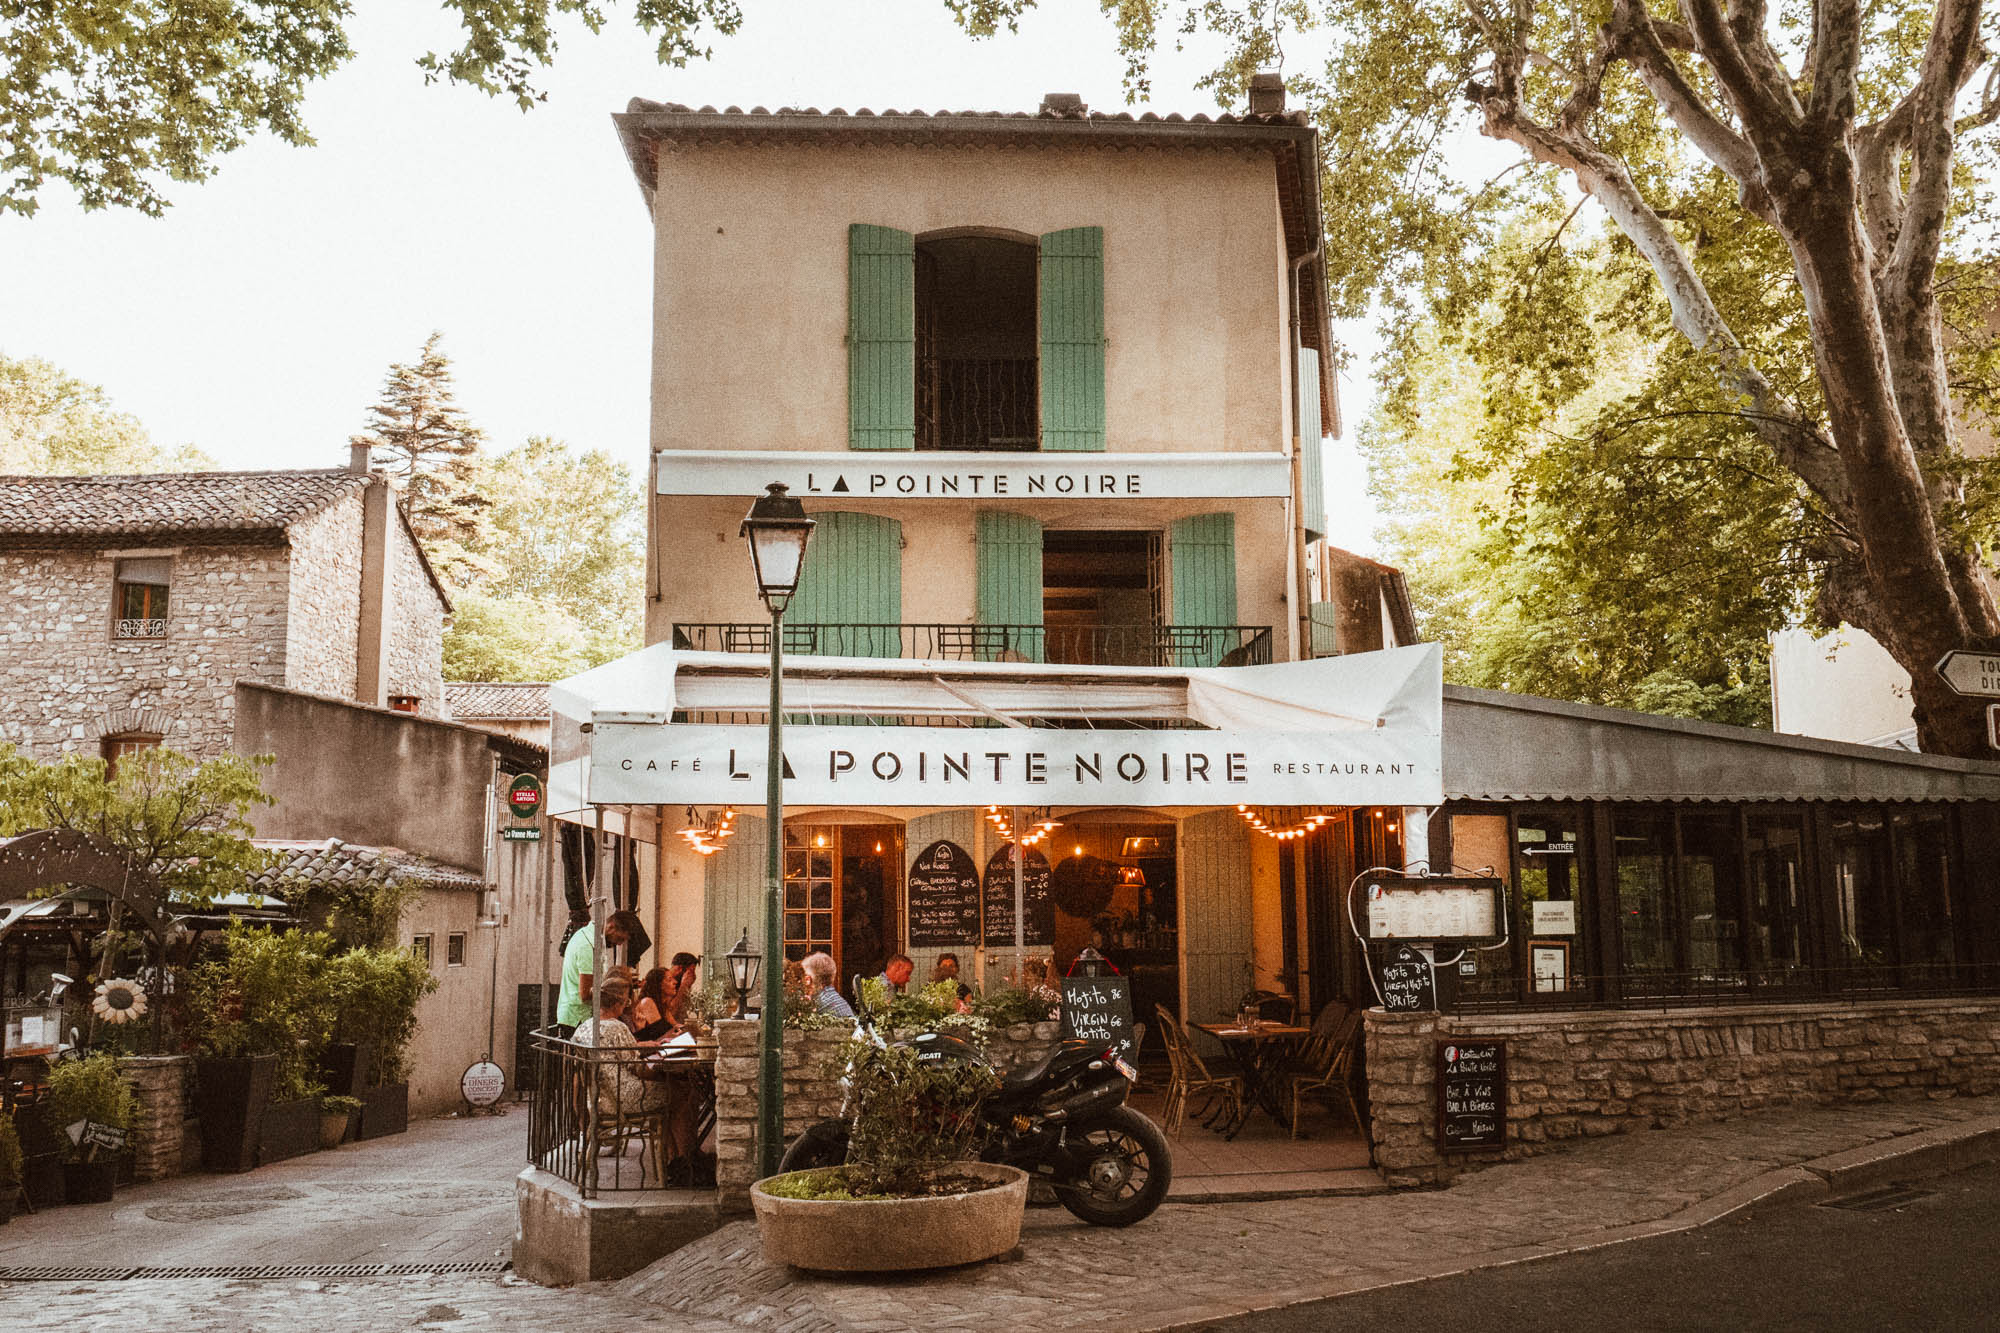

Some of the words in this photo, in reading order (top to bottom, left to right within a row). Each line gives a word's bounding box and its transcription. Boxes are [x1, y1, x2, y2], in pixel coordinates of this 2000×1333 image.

[809, 473, 850, 493] LA
[870, 474, 1007, 494] POINTE
[1028, 474, 1140, 494] NOIRE
[621, 757, 701, 772] CAFÉ
[829, 750, 1048, 784] POINTE
[1075, 752, 1248, 785] NOIRE
[1273, 762, 1416, 776] RESTAURANT
[1548, 842, 1574, 850] ENTRÉE
[1067, 984, 1107, 1009] Mojito
[918, 1052, 941, 1060] UCATI
